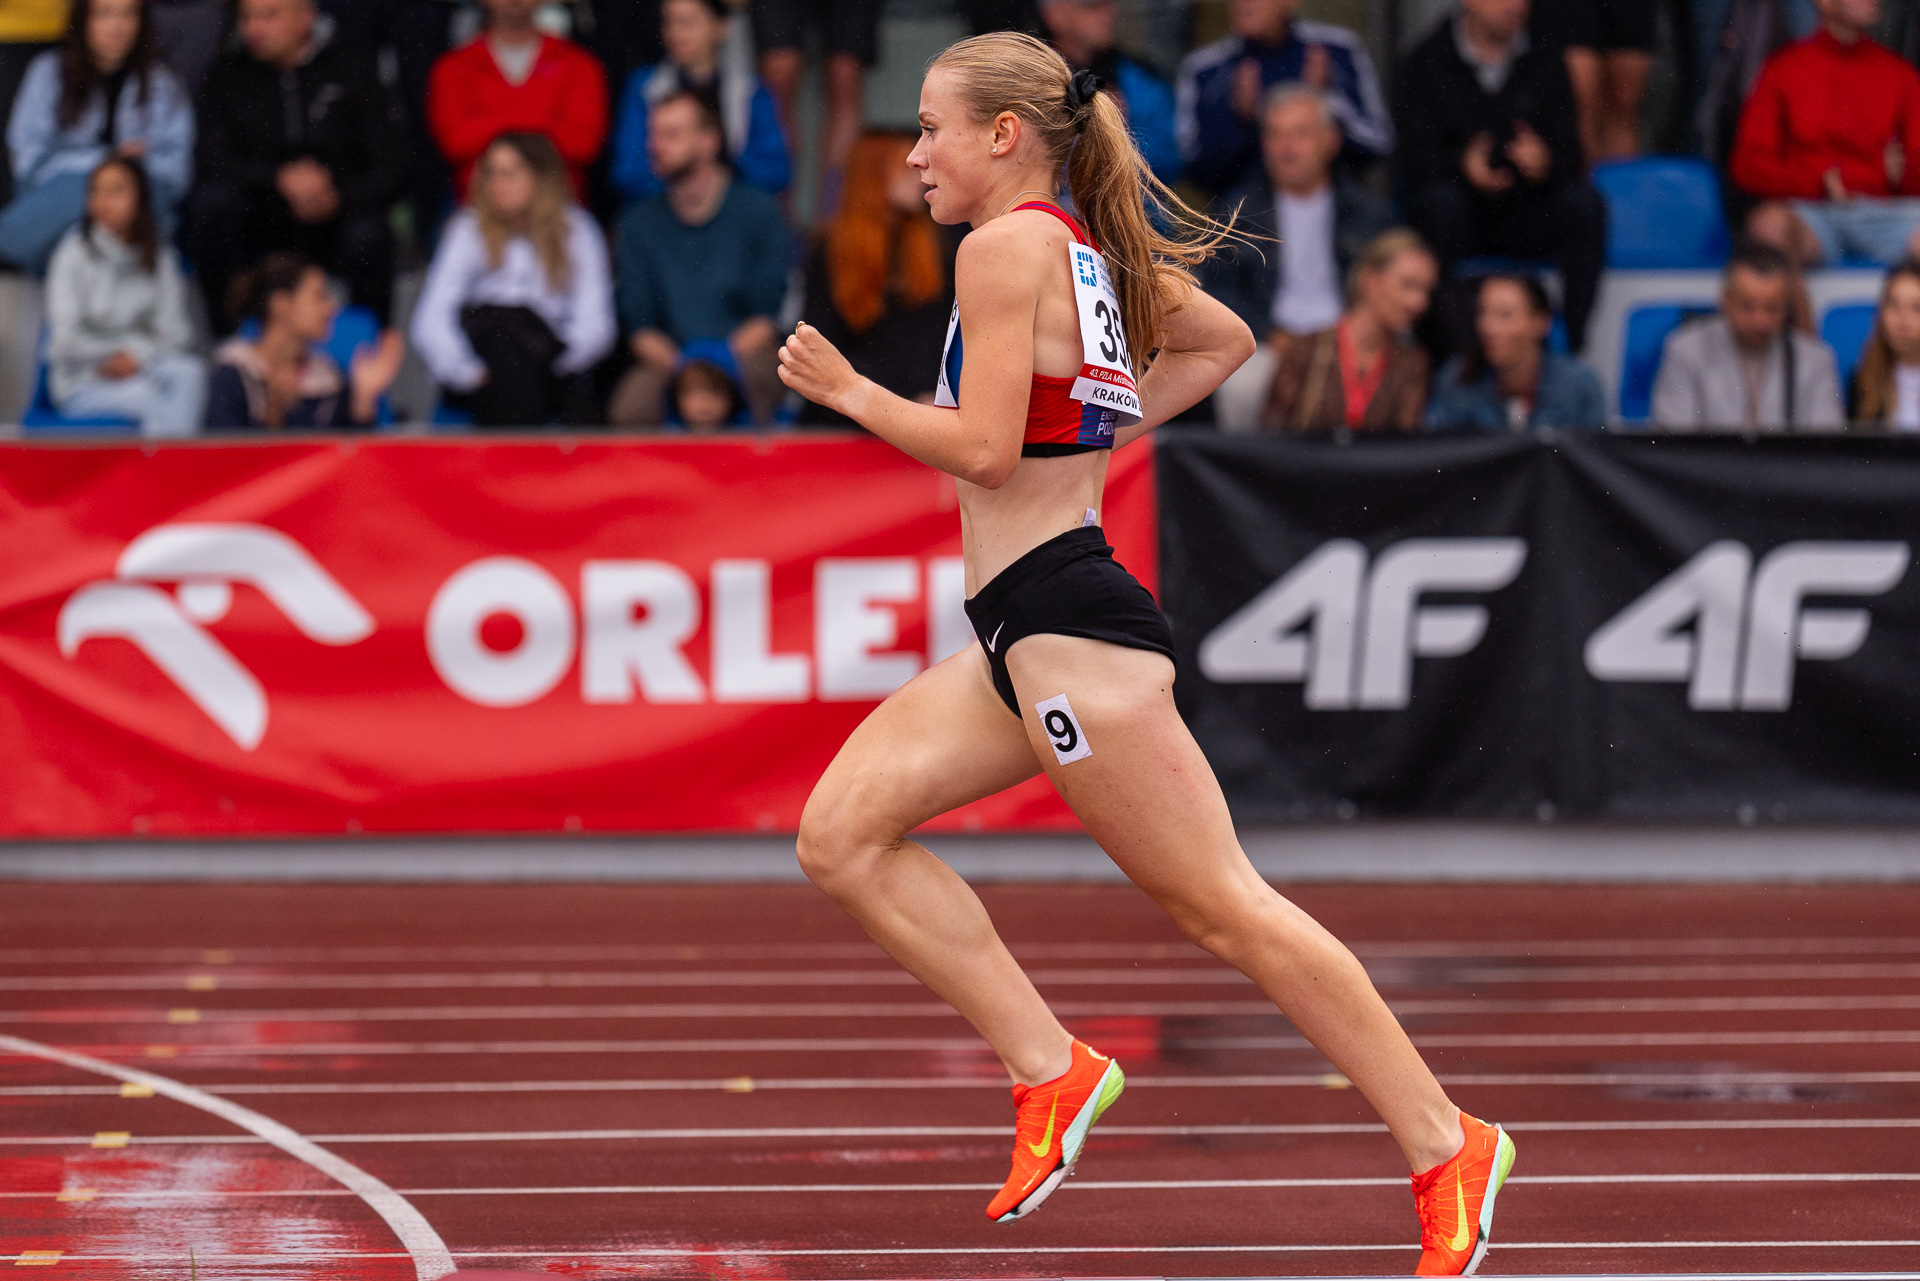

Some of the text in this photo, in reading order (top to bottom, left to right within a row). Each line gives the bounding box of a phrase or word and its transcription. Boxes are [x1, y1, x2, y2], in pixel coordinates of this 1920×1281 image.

[1095, 300, 1135, 378] 35
[1089, 368, 1098, 379] 43.
[1098, 370, 1112, 382] PZLA
[1092, 387, 1137, 409] KRAKÓW
[1199, 537, 1528, 710] 4F
[1584, 540, 1910, 712] 4F
[1044, 709, 1078, 753] 9
